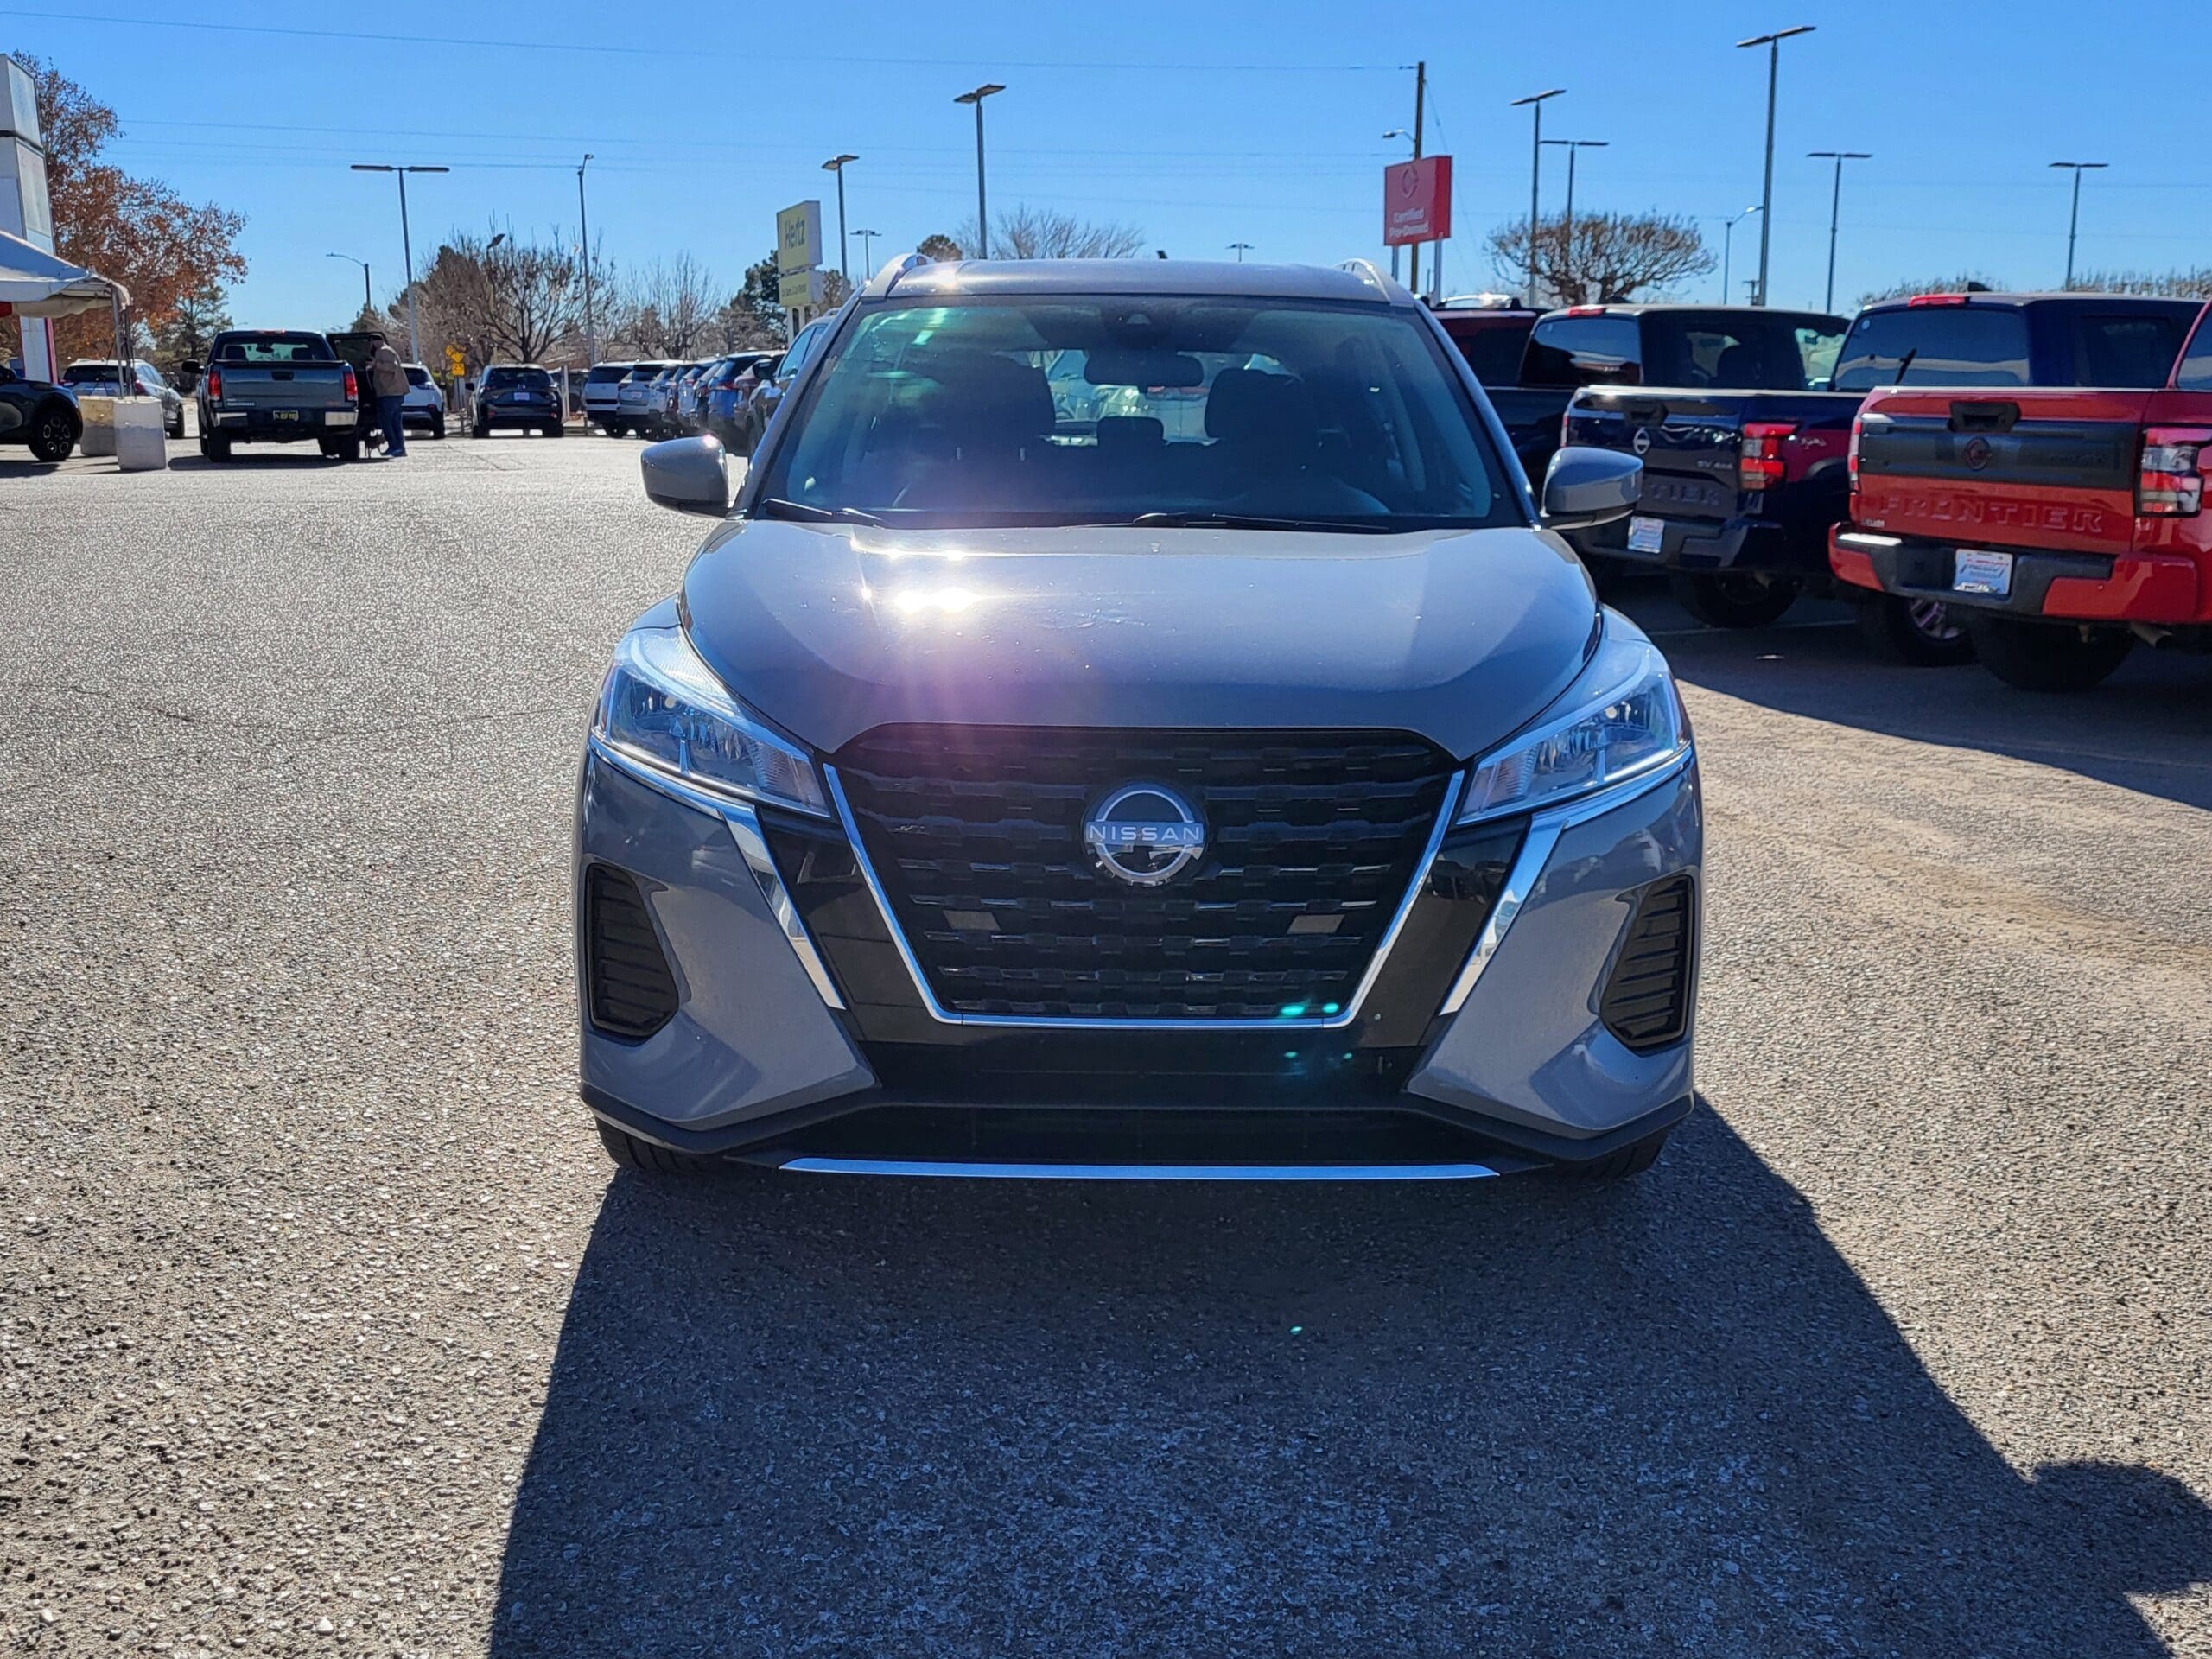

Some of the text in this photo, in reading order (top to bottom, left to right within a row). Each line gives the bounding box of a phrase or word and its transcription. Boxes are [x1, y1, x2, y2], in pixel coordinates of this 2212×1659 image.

[785, 217, 805, 250] Hertz
[1649, 483, 1722, 505] TIER
[1880, 496, 2102, 533] FRONTIER
[1089, 825, 1200, 842] NISSAN
